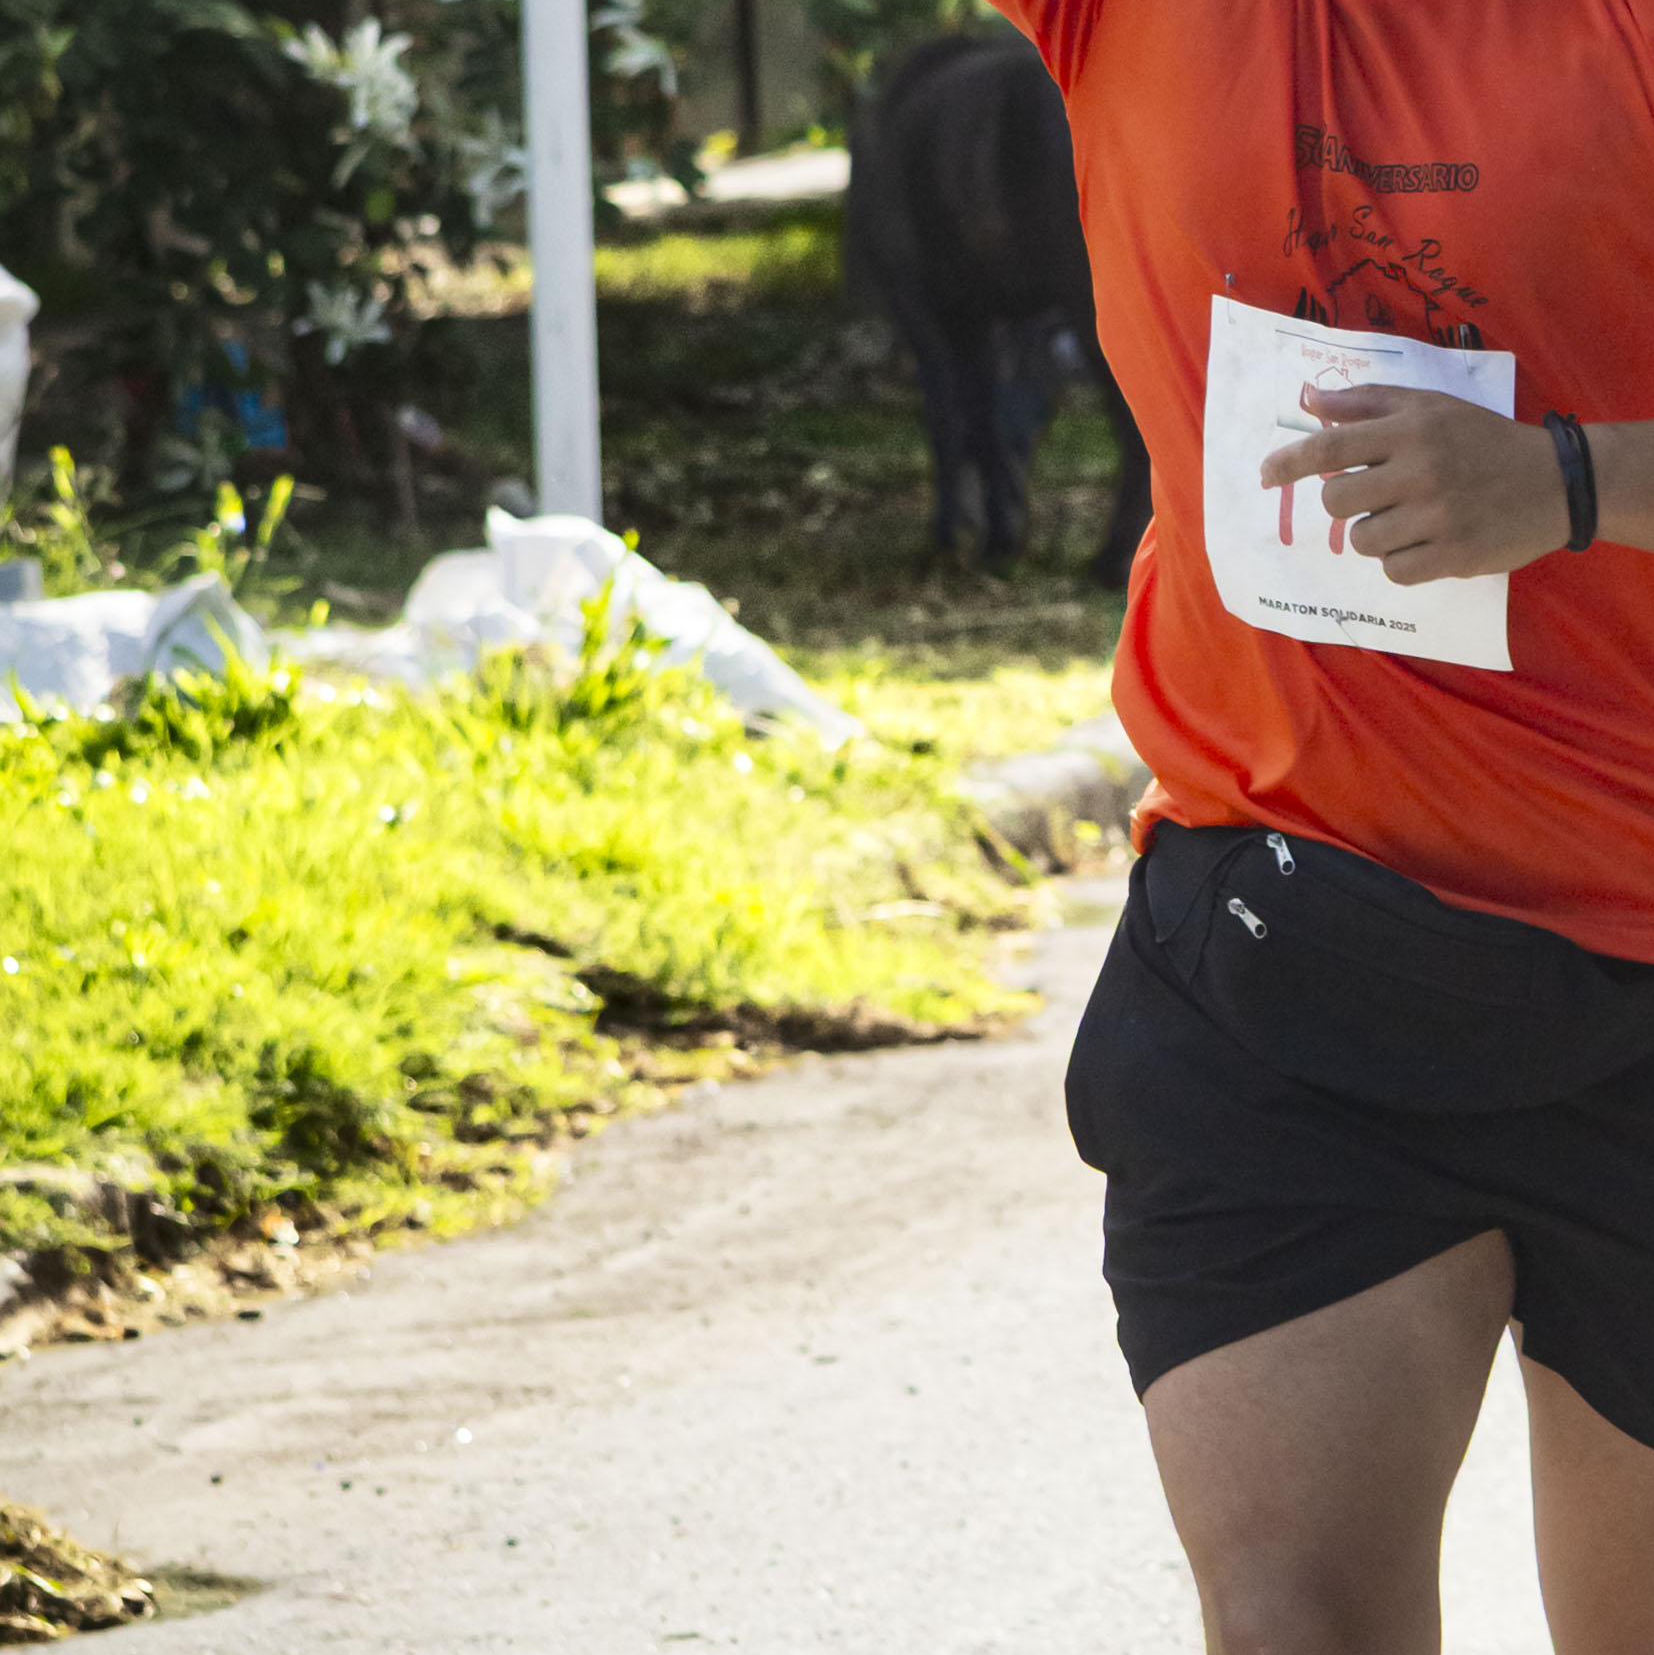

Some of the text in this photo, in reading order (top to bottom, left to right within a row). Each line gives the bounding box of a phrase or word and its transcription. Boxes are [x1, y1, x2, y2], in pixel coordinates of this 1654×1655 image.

[1322, 135, 1480, 194] ANIVERSARIO
[1350, 204, 1394, 250] San
[1401, 238, 1489, 308] Roque
[1258, 596, 1417, 634] MARATON SOLIDARIA 2025
